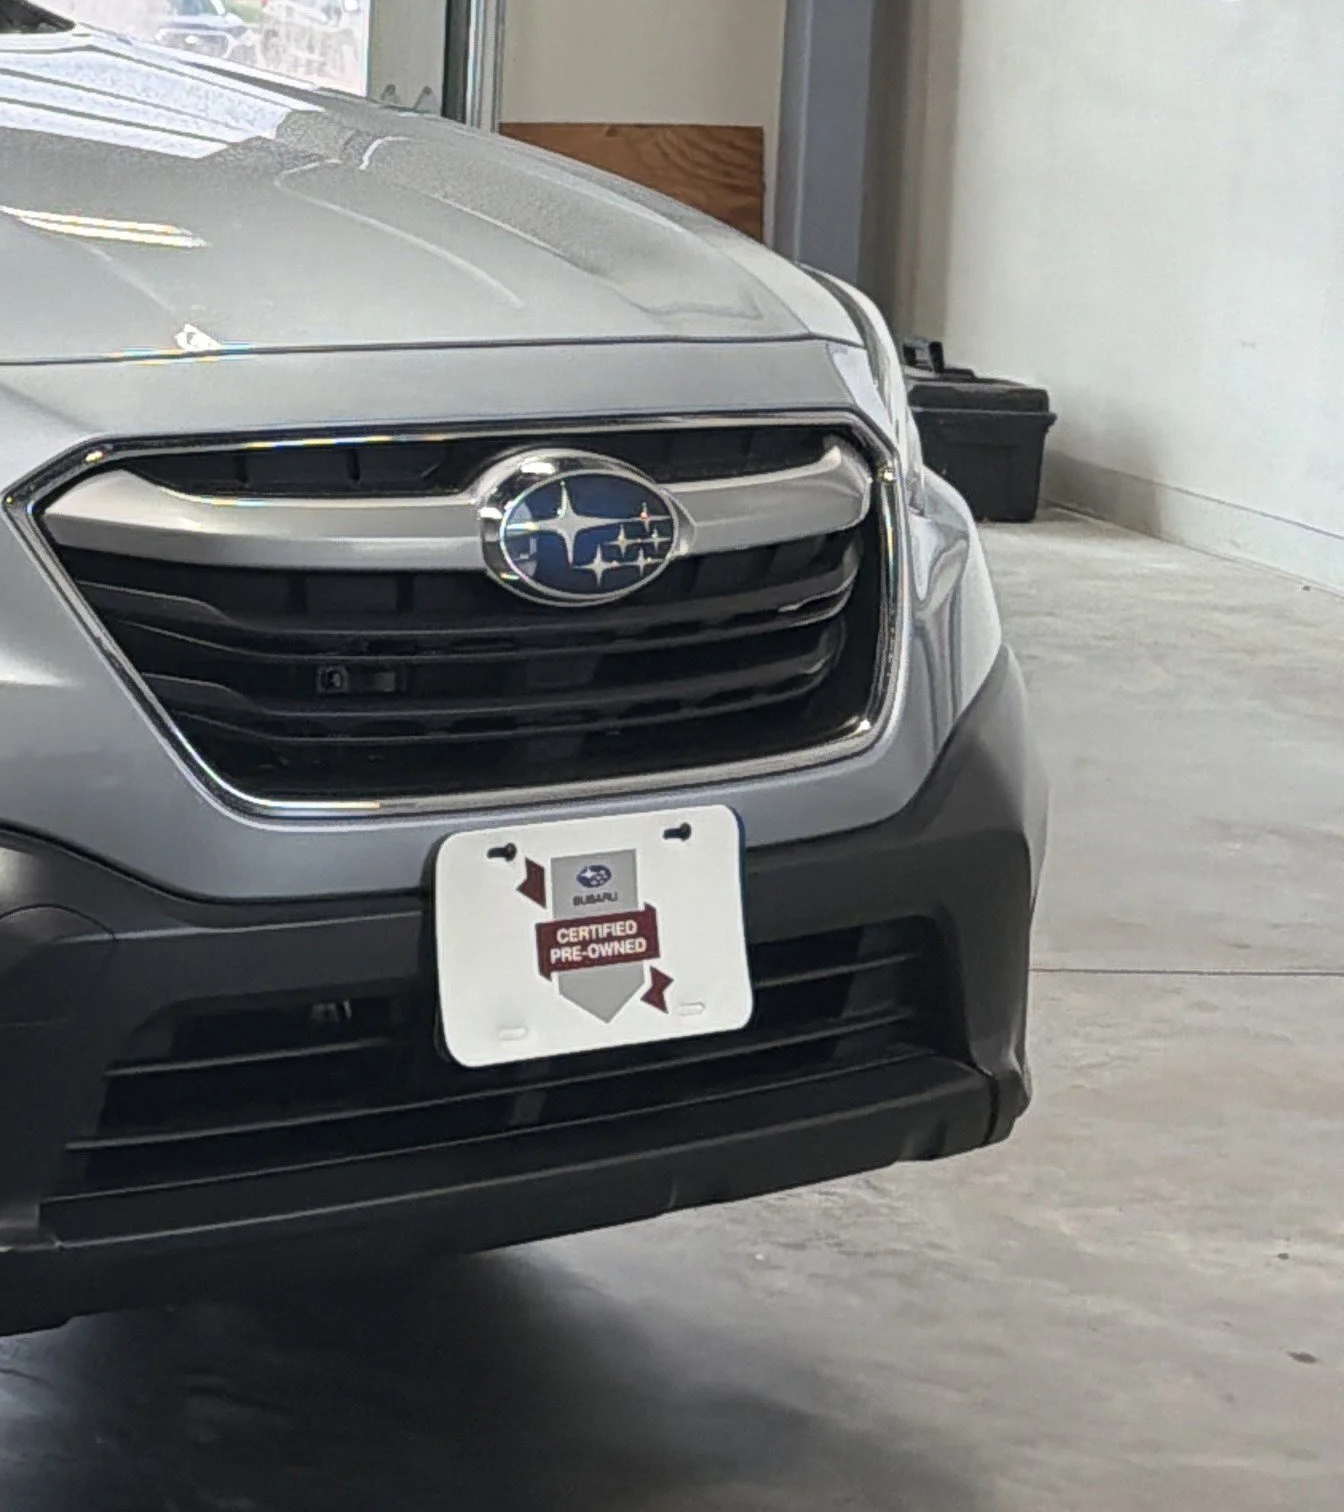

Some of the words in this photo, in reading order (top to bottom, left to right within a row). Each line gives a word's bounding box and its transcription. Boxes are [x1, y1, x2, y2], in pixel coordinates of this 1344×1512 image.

[572, 891, 619, 906] SUBARU
[556, 919, 638, 944] CERTIFIED
[550, 937, 647, 964] PRE-OWNED
